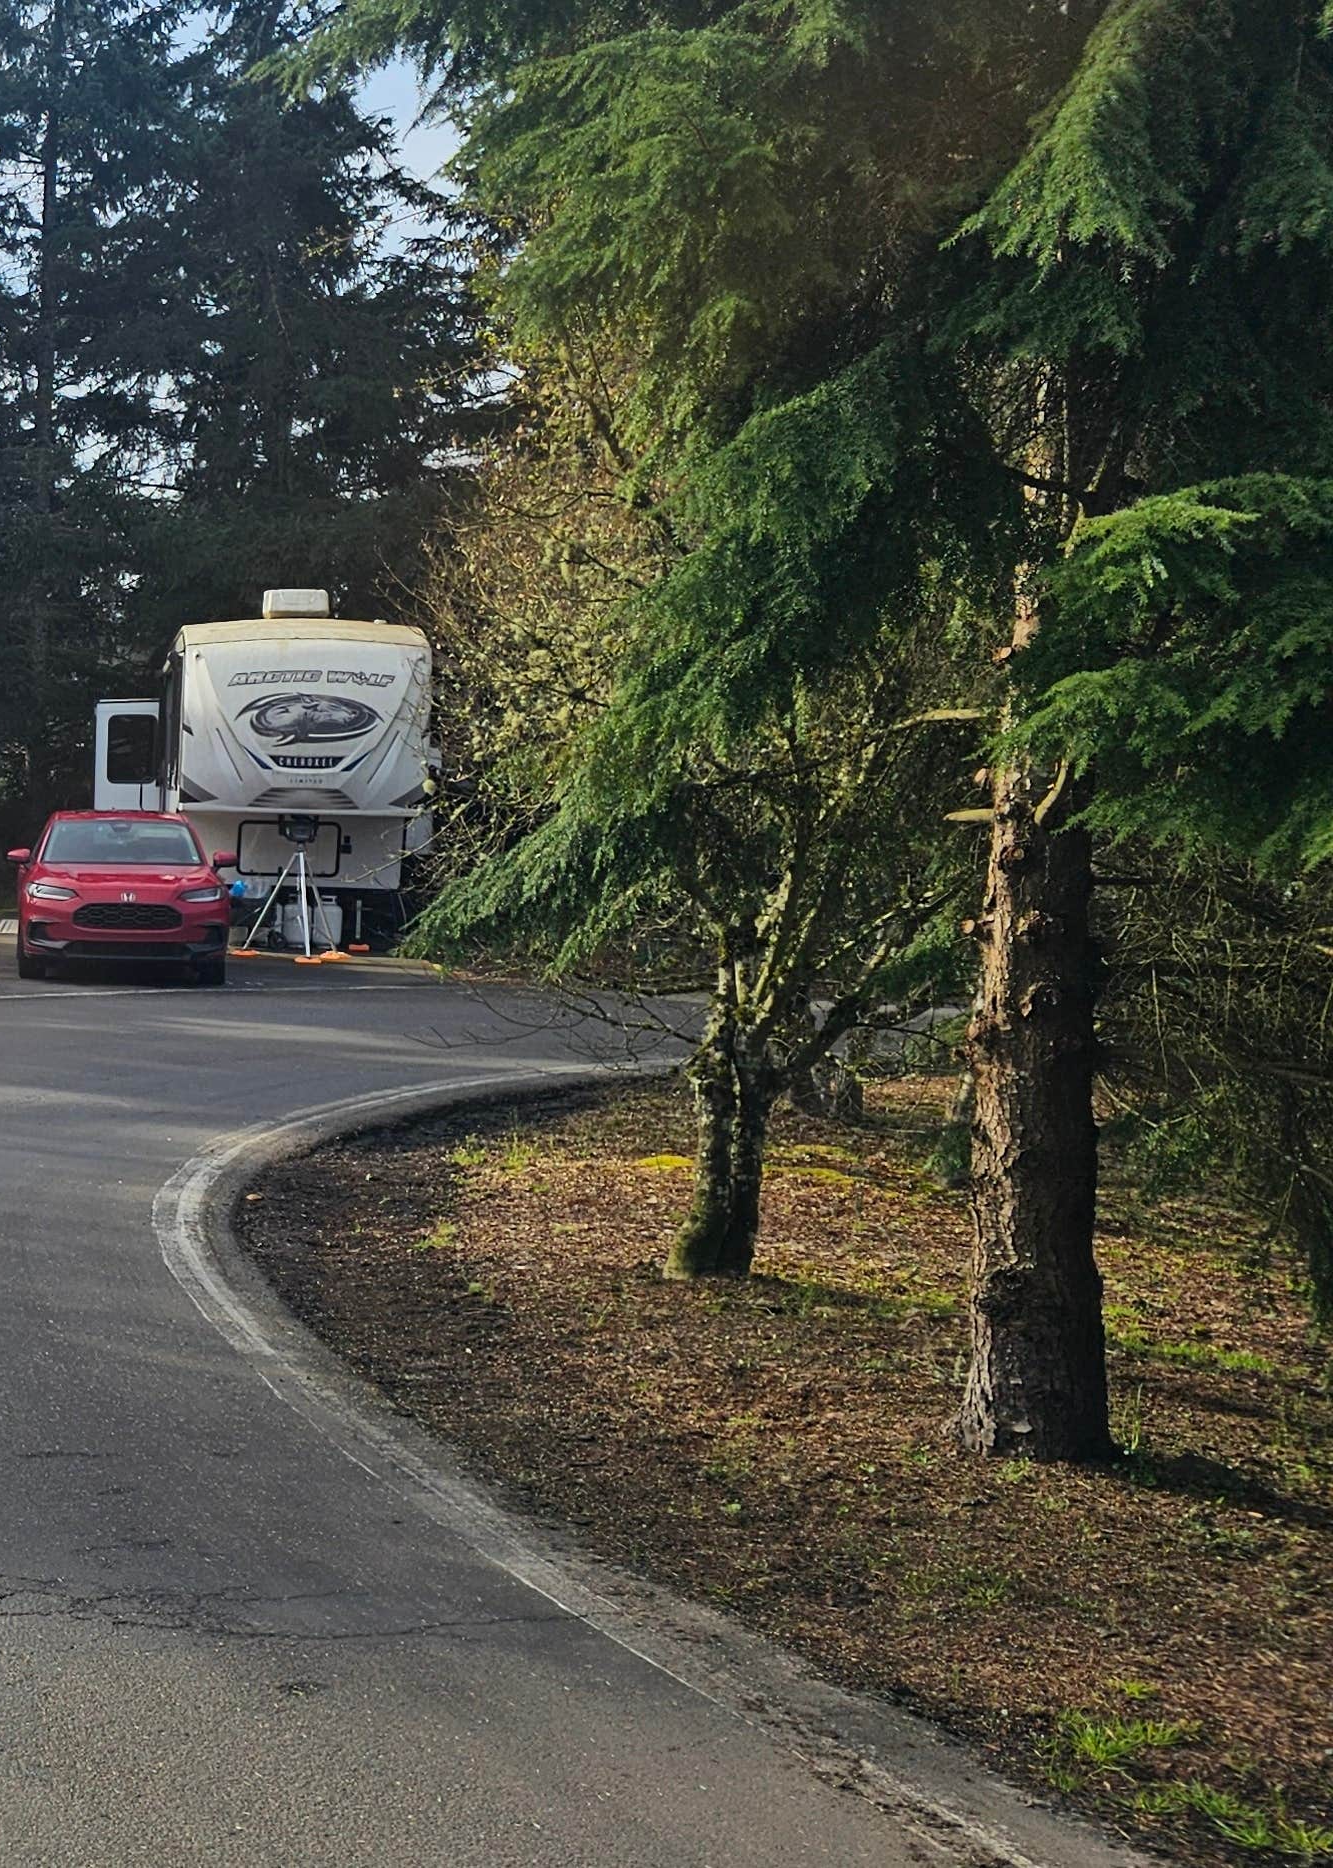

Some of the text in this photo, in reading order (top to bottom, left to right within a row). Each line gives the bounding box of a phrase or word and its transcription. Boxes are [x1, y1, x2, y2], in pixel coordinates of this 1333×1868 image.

[227, 669, 397, 688] ARCTIC WOLF
[278, 756, 333, 767] CHEROKEE
